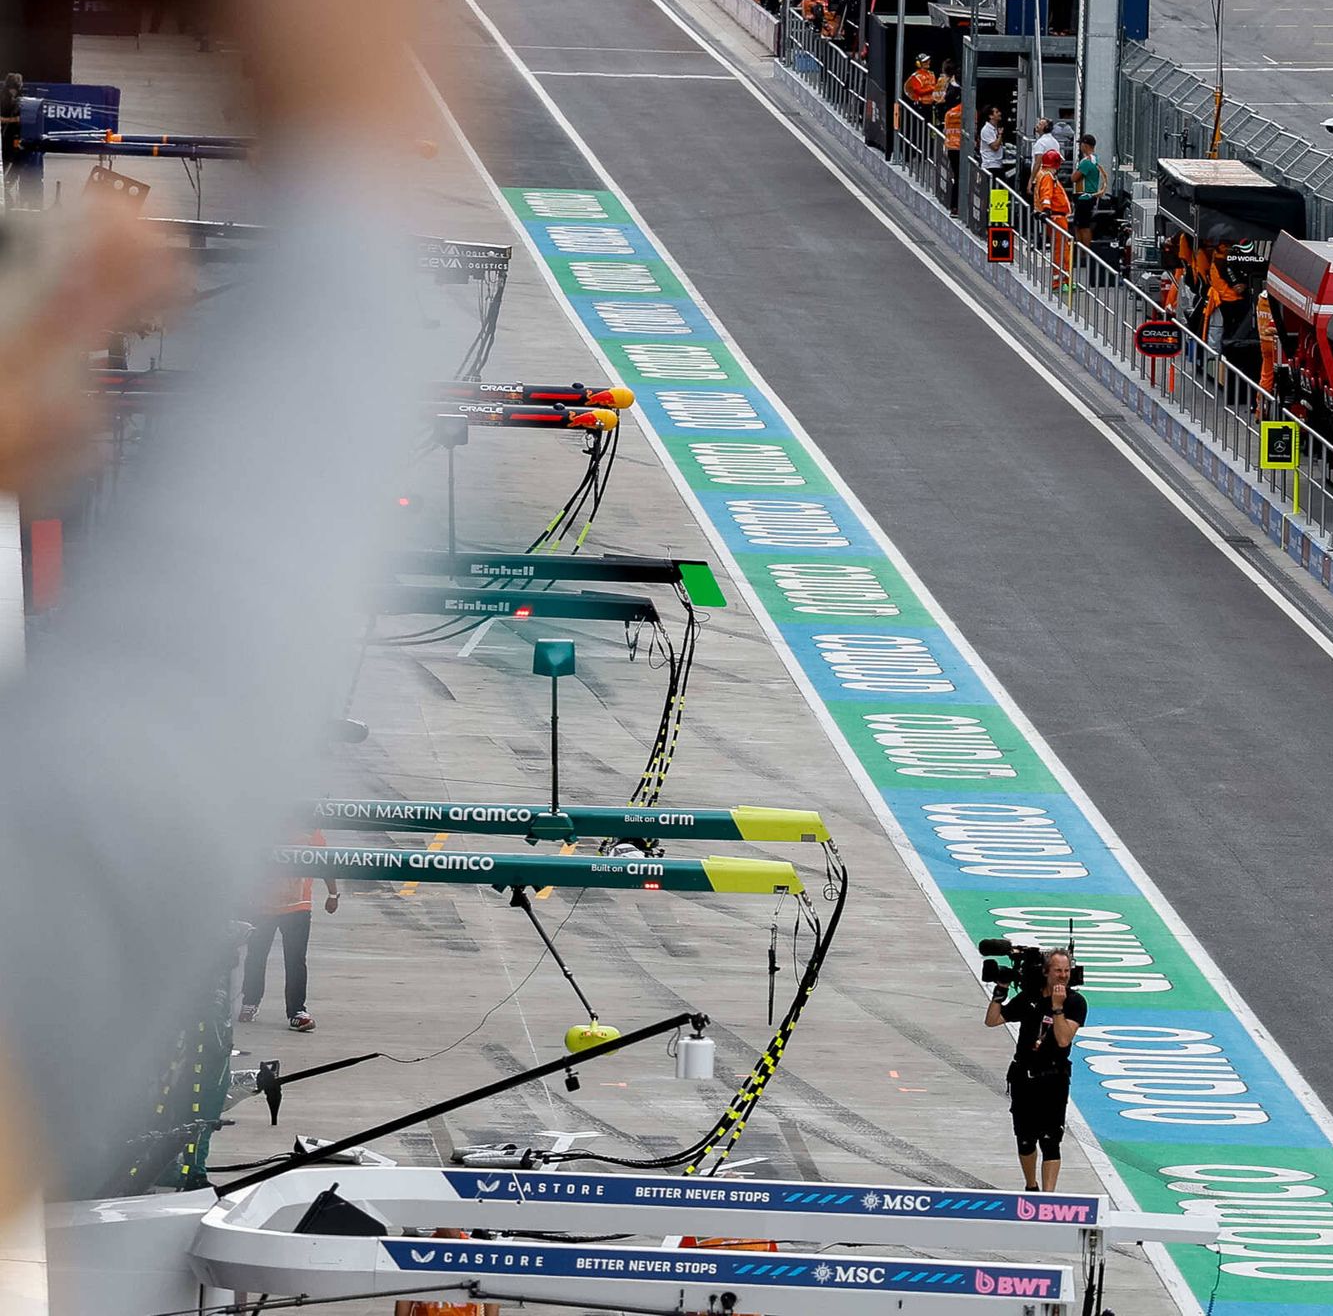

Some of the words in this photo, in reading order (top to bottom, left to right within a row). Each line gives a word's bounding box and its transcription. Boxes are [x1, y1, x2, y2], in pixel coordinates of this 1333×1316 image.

[43, 103, 92, 120] ERMÉ
[459, 405, 503, 414] ORACLE
[480, 384, 524, 393] ORACLE
[687, 442, 806, 486] aramco
[725, 499, 851, 548] aramco
[471, 564, 535, 577] Einhell
[765, 562, 900, 616] aramco
[445, 599, 510, 613] Einhell
[811, 634, 956, 693] aramco
[862, 713, 1017, 779] aramco
[314, 803, 370, 818] ASTON
[375, 805, 442, 820] MARTIN
[449, 806, 531, 822] aramco
[624, 813, 643, 824] Built
[645, 815, 655, 824] on
[658, 811, 694, 826] arm
[920, 803, 1089, 879] aramco
[333, 851, 402, 868] MARTIN
[409, 853, 494, 871] aramco
[591, 863, 611, 874] Built
[613, 865, 624, 874] on
[627, 861, 664, 876] arm
[1074, 1025, 1271, 1126] aramco
[508, 1181, 605, 1197] CASTORE
[635, 1186, 682, 1200] BETTER
[685, 1188, 727, 1201] NEVER
[729, 1190, 771, 1203] STOPS
[882, 1194, 931, 1211] MSC
[1038, 1203, 1090, 1222] BWT
[443, 1251, 544, 1268] CASTORE
[576, 1257, 624, 1272] BETTER
[628, 1259, 671, 1273] NEVER
[675, 1261, 718, 1275] STOPS
[834, 1266, 885, 1283] MSC
[997, 1276, 1051, 1296] BWT
